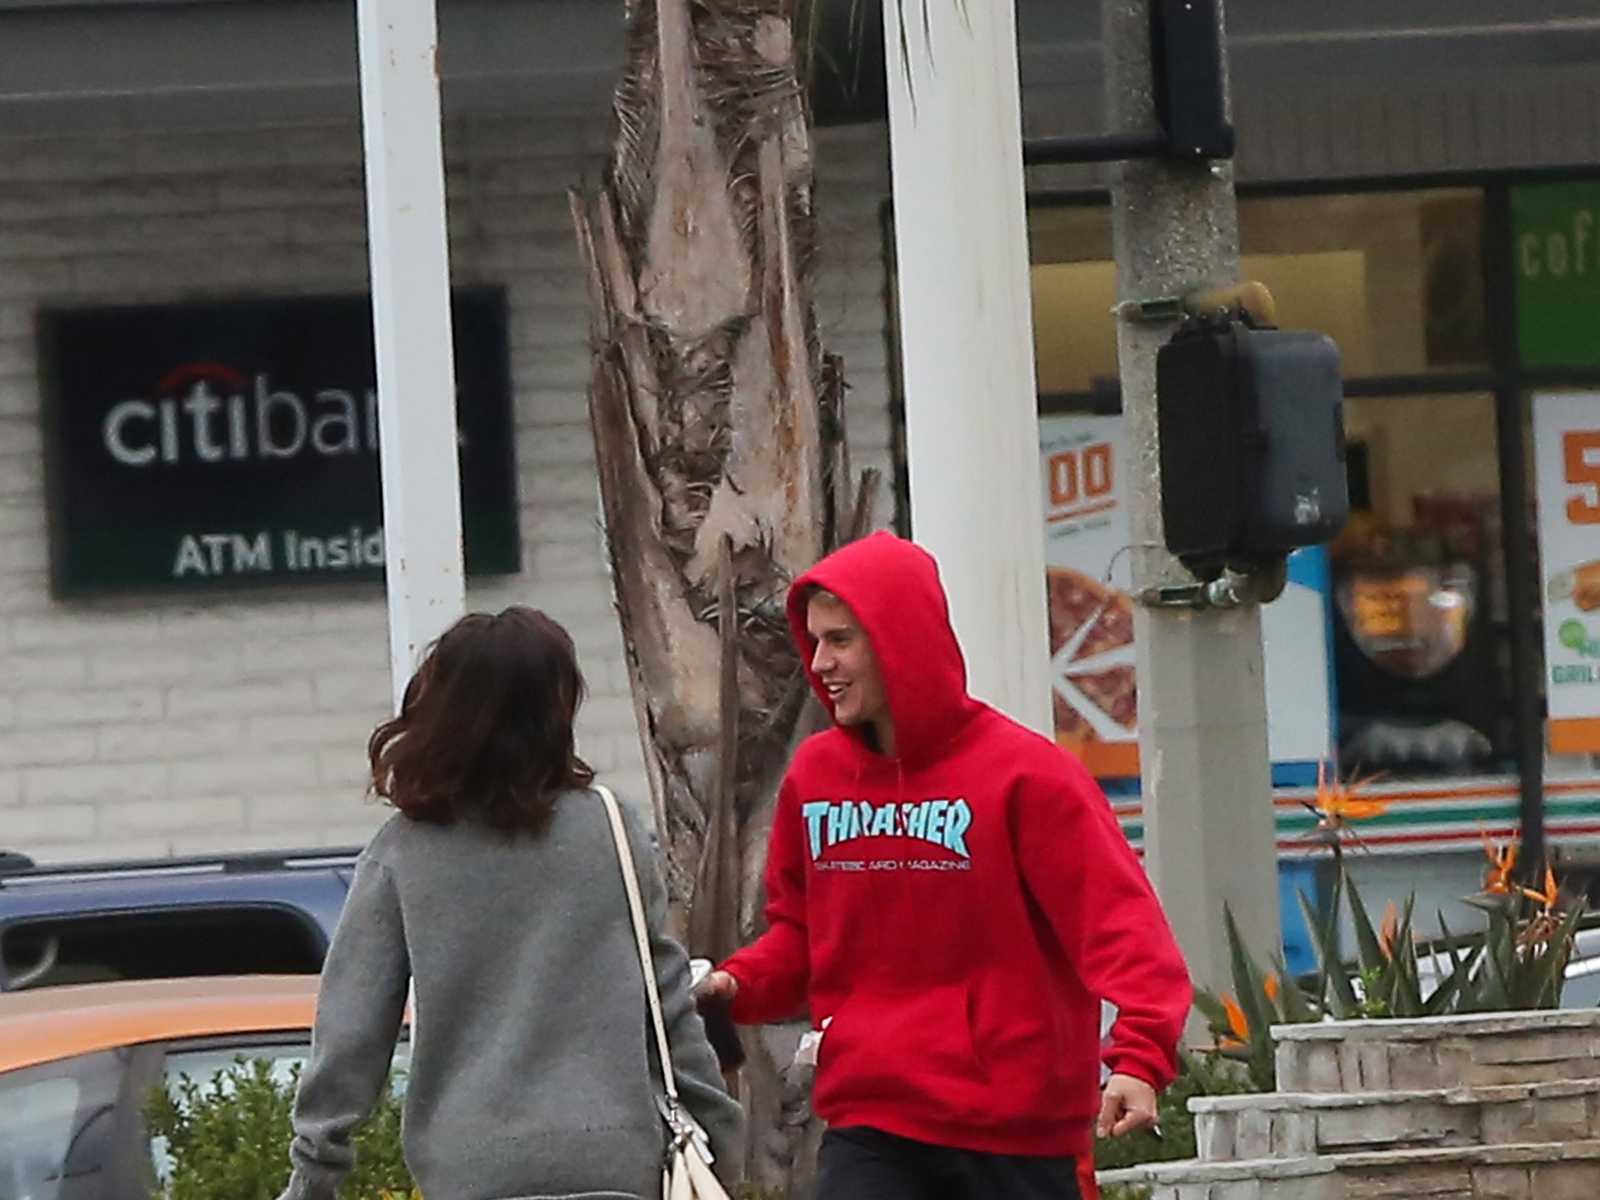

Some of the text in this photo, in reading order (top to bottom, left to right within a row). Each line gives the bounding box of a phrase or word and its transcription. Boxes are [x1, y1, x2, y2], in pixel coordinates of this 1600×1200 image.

[1519, 209, 1600, 277] cof
[103, 371, 466, 466] citiba
[172, 525, 386, 577] ATM Insid
